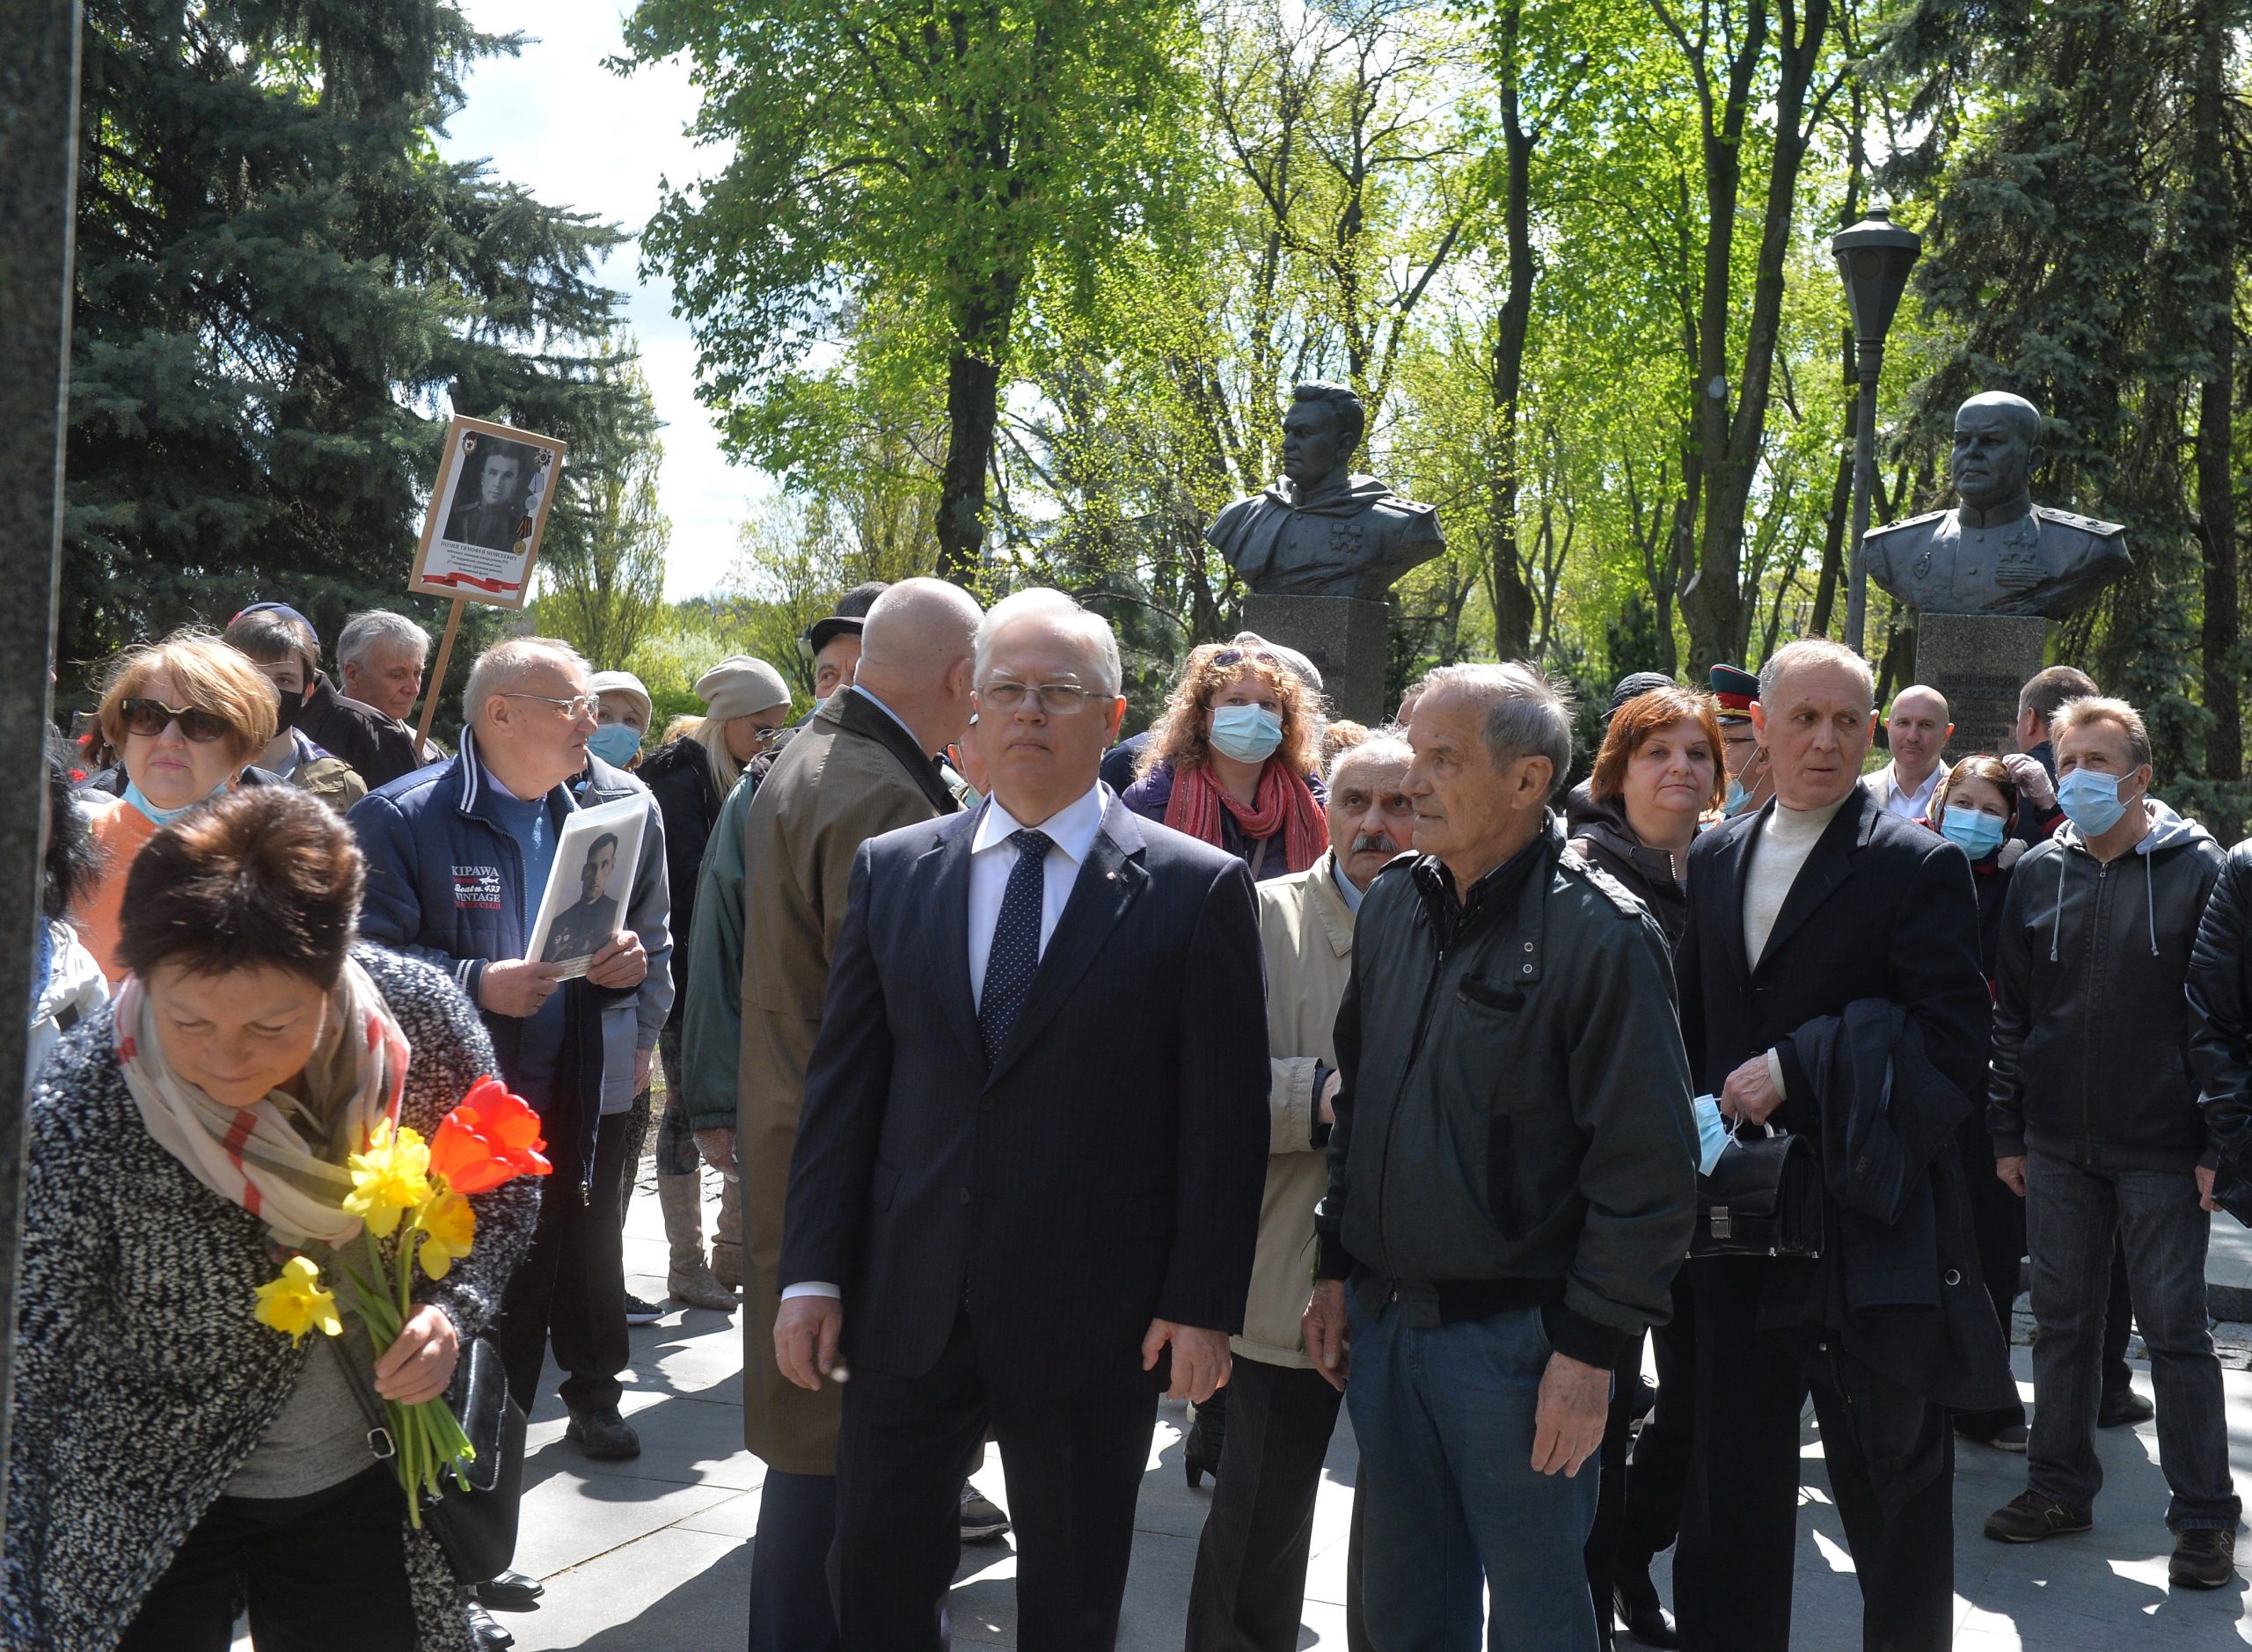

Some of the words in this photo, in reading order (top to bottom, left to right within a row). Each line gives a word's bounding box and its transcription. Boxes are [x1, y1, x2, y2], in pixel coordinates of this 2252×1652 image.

[460, 545, 486, 555] ТИМОФЕЙ
[451, 866, 501, 876] KIPAWA
[455, 893, 501, 902] VINTAGE
